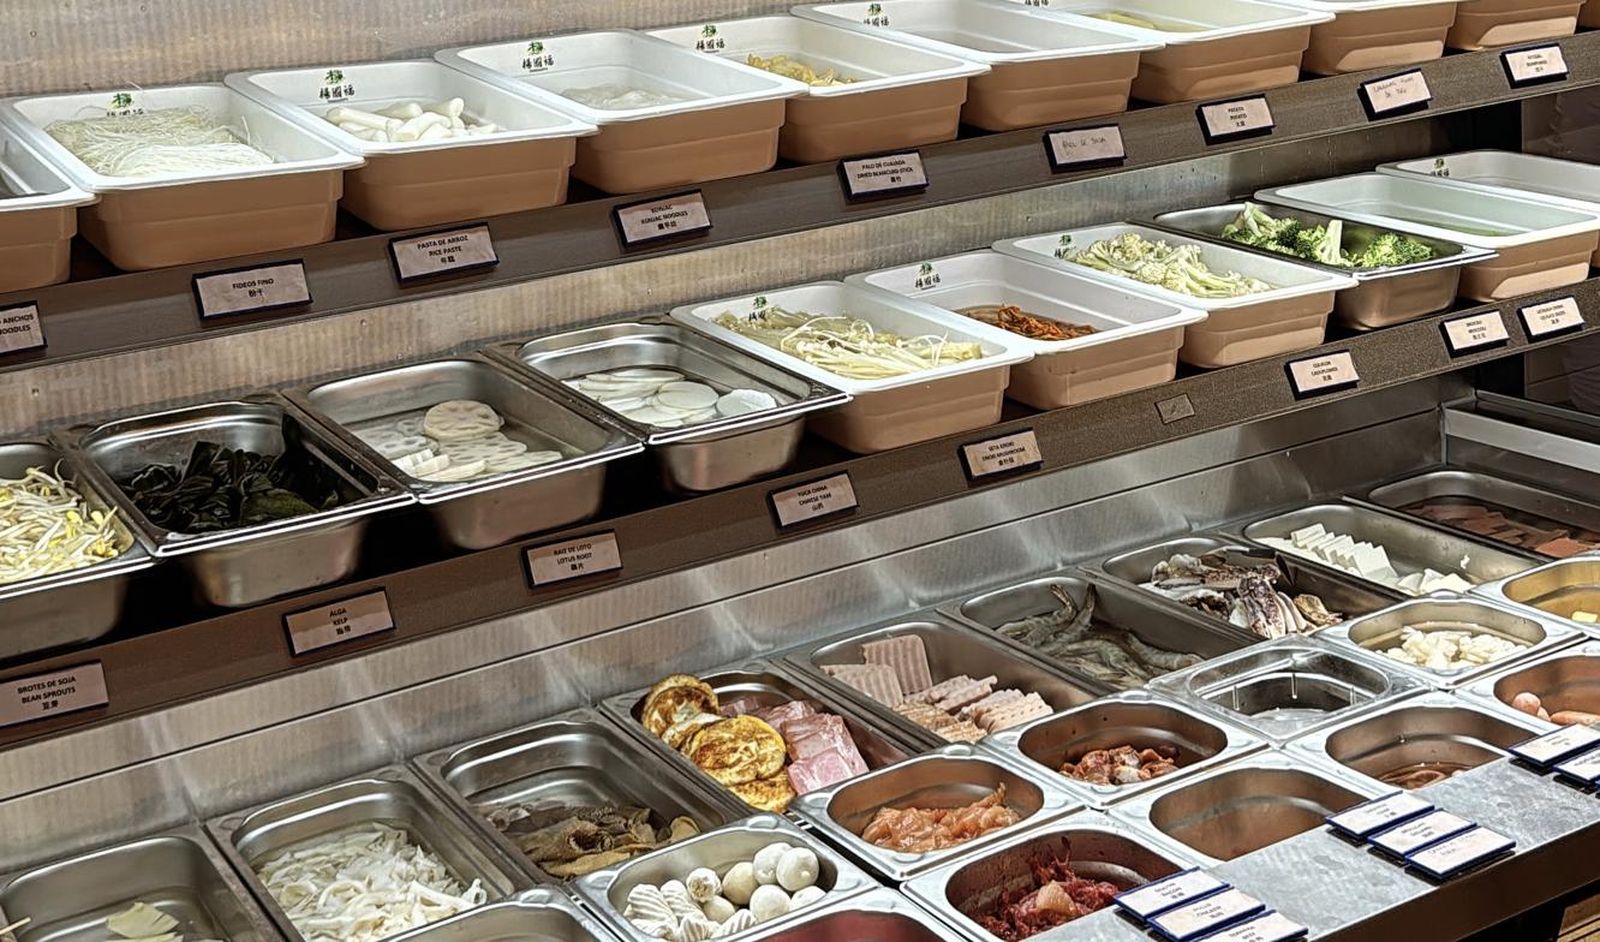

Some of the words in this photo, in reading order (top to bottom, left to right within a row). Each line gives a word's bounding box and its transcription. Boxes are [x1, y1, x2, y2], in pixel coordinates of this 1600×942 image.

[883, 160, 906, 168] CUAJADA
[857, 171, 873, 179] DRIED
[641, 215, 662, 225] KONJAC
[662, 211, 688, 220] NOODLES
[417, 239, 437, 249] PASTA
[437, 237, 447, 246] DE
[447, 235, 469, 245] ARROZ
[428, 248, 442, 257] RICE
[443, 245, 462, 254] PASTE
[232, 280, 256, 290] FIDEOS
[257, 278, 275, 287] FINO
[2, 314, 34, 326] ANCHOS
[996, 446, 1026, 459] MUSHROOM
[797, 488, 811, 498] YUCA
[811, 485, 828, 495] CHINA
[799, 495, 819, 506] CHINESE
[819, 493, 832, 501] YAM
[568, 545, 576, 554] DE
[576, 543, 592, 553] LOTO
[556, 555, 575, 566] LOTUS
[575, 552, 592, 562] ROOT
[329, 607, 348, 618] ALGA
[333, 617, 348, 627] KELP
[17, 682, 46, 694] BROTES
[46, 680, 57, 690] DE
[57, 676, 77, 687] SOJA
[21, 692, 42, 704] BEAN
[42, 685, 76, 700] SPROUTS
